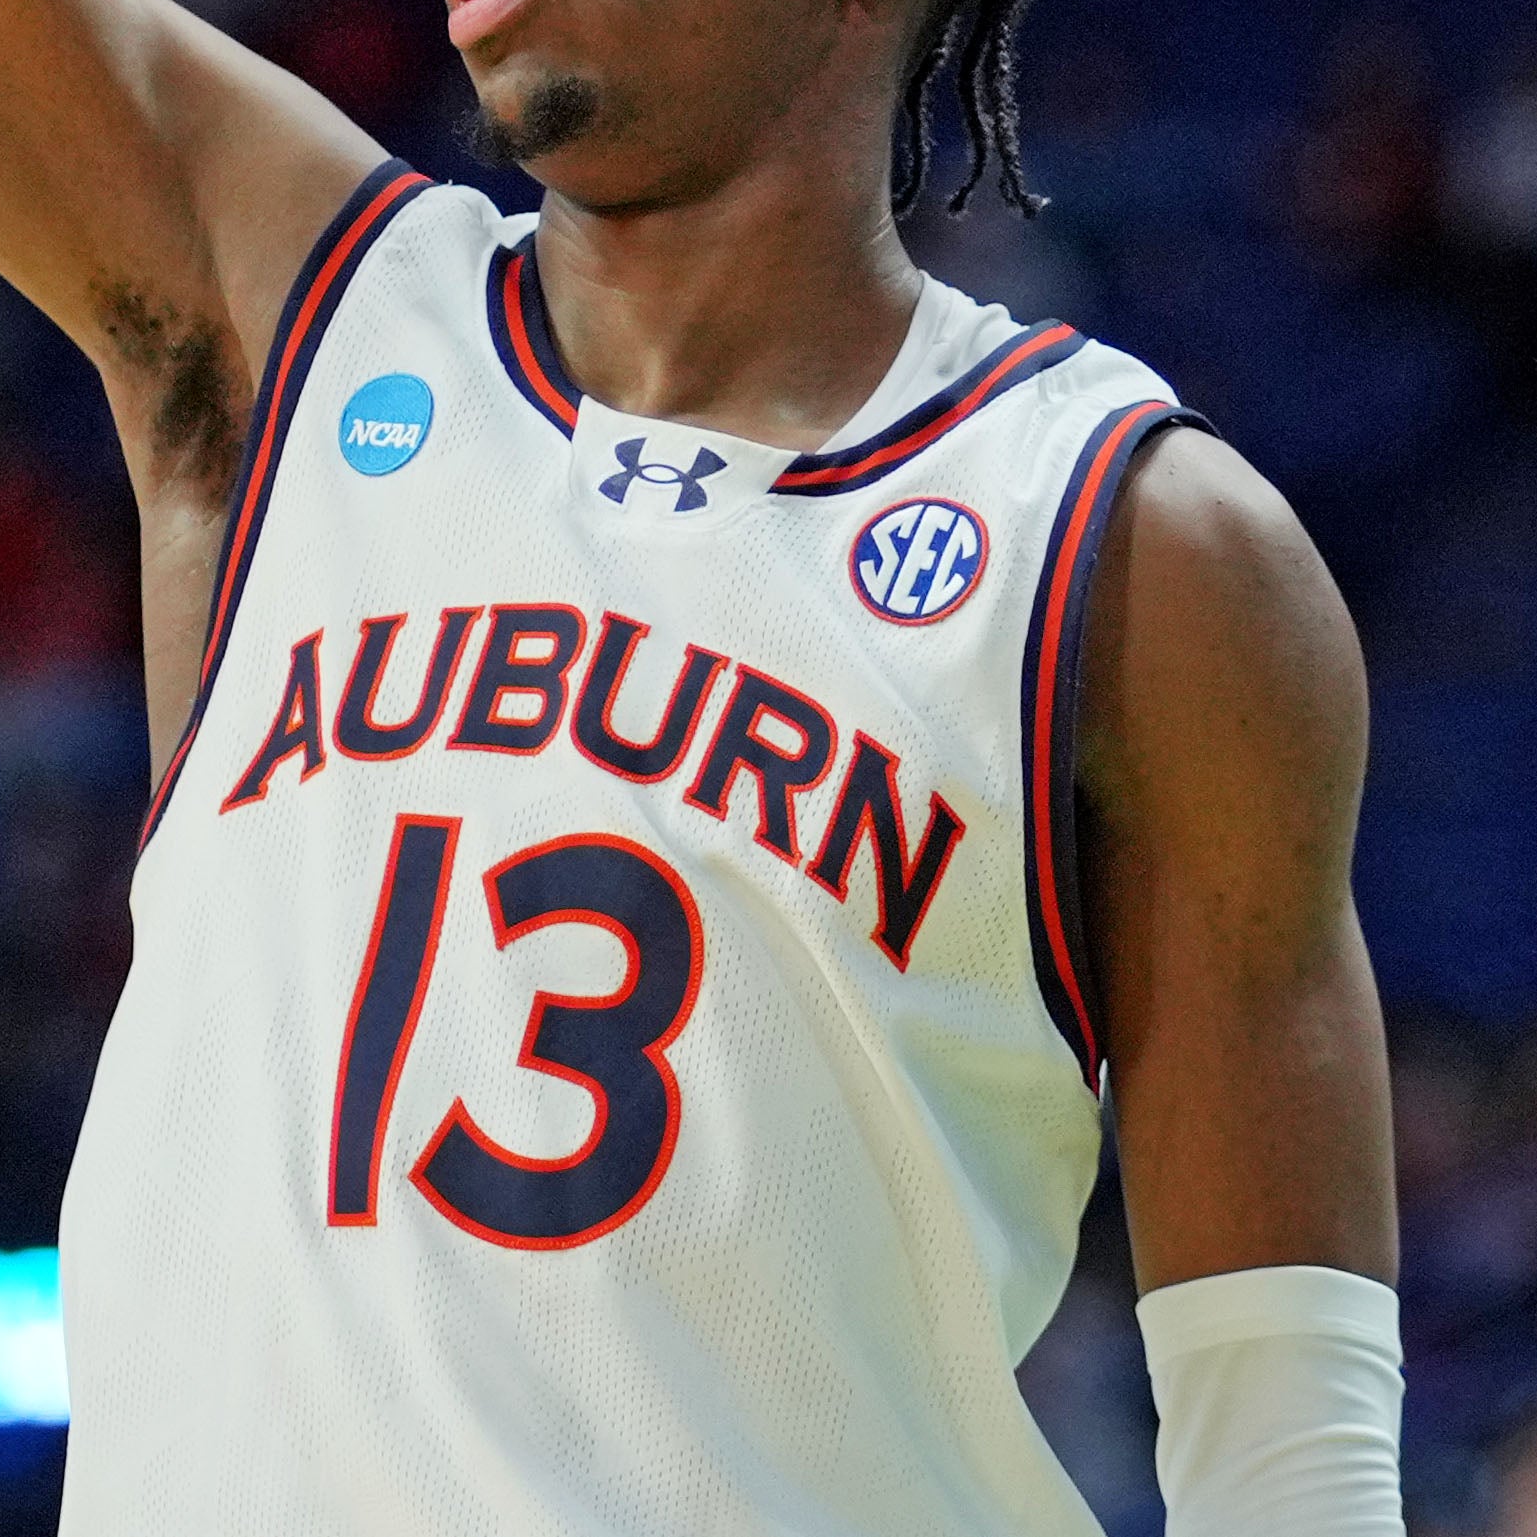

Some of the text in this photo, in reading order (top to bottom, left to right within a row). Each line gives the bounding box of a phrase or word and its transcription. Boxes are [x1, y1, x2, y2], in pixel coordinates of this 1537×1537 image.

[346, 418, 421, 449] NCAA
[859, 503, 978, 615] SEC
[219, 603, 965, 972] AUBURN
[327, 814, 704, 1251] 13
